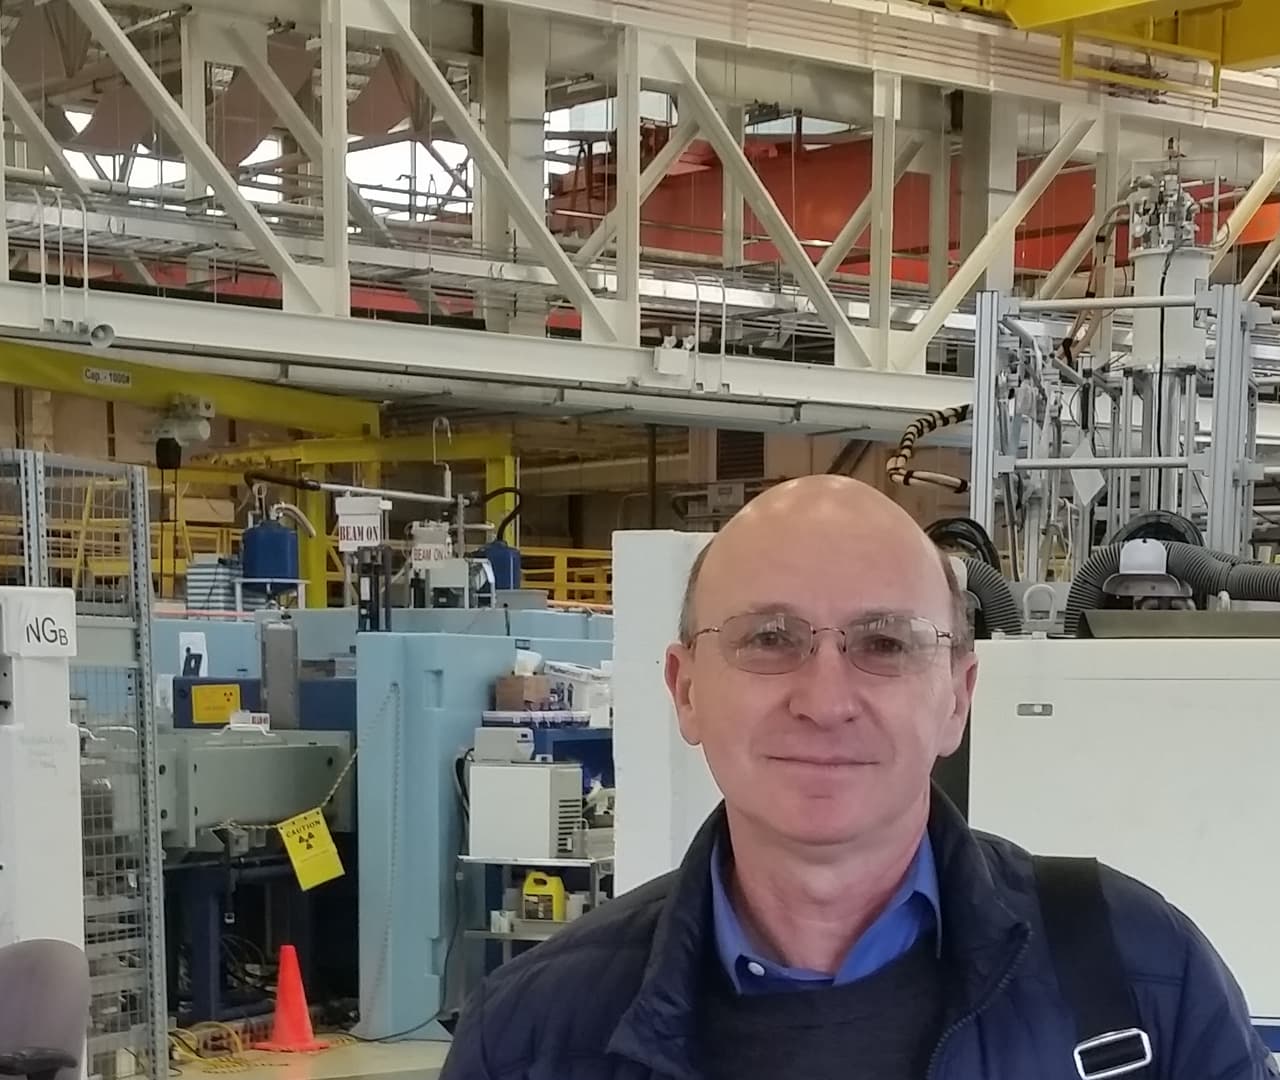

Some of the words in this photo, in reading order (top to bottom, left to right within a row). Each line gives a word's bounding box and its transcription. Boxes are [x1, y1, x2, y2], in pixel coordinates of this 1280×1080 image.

[340, 525, 364, 541] BEAM
[366, 525, 379, 541] ON
[413, 547, 432, 561] BEAM
[286, 820, 321, 838] CAUTION
